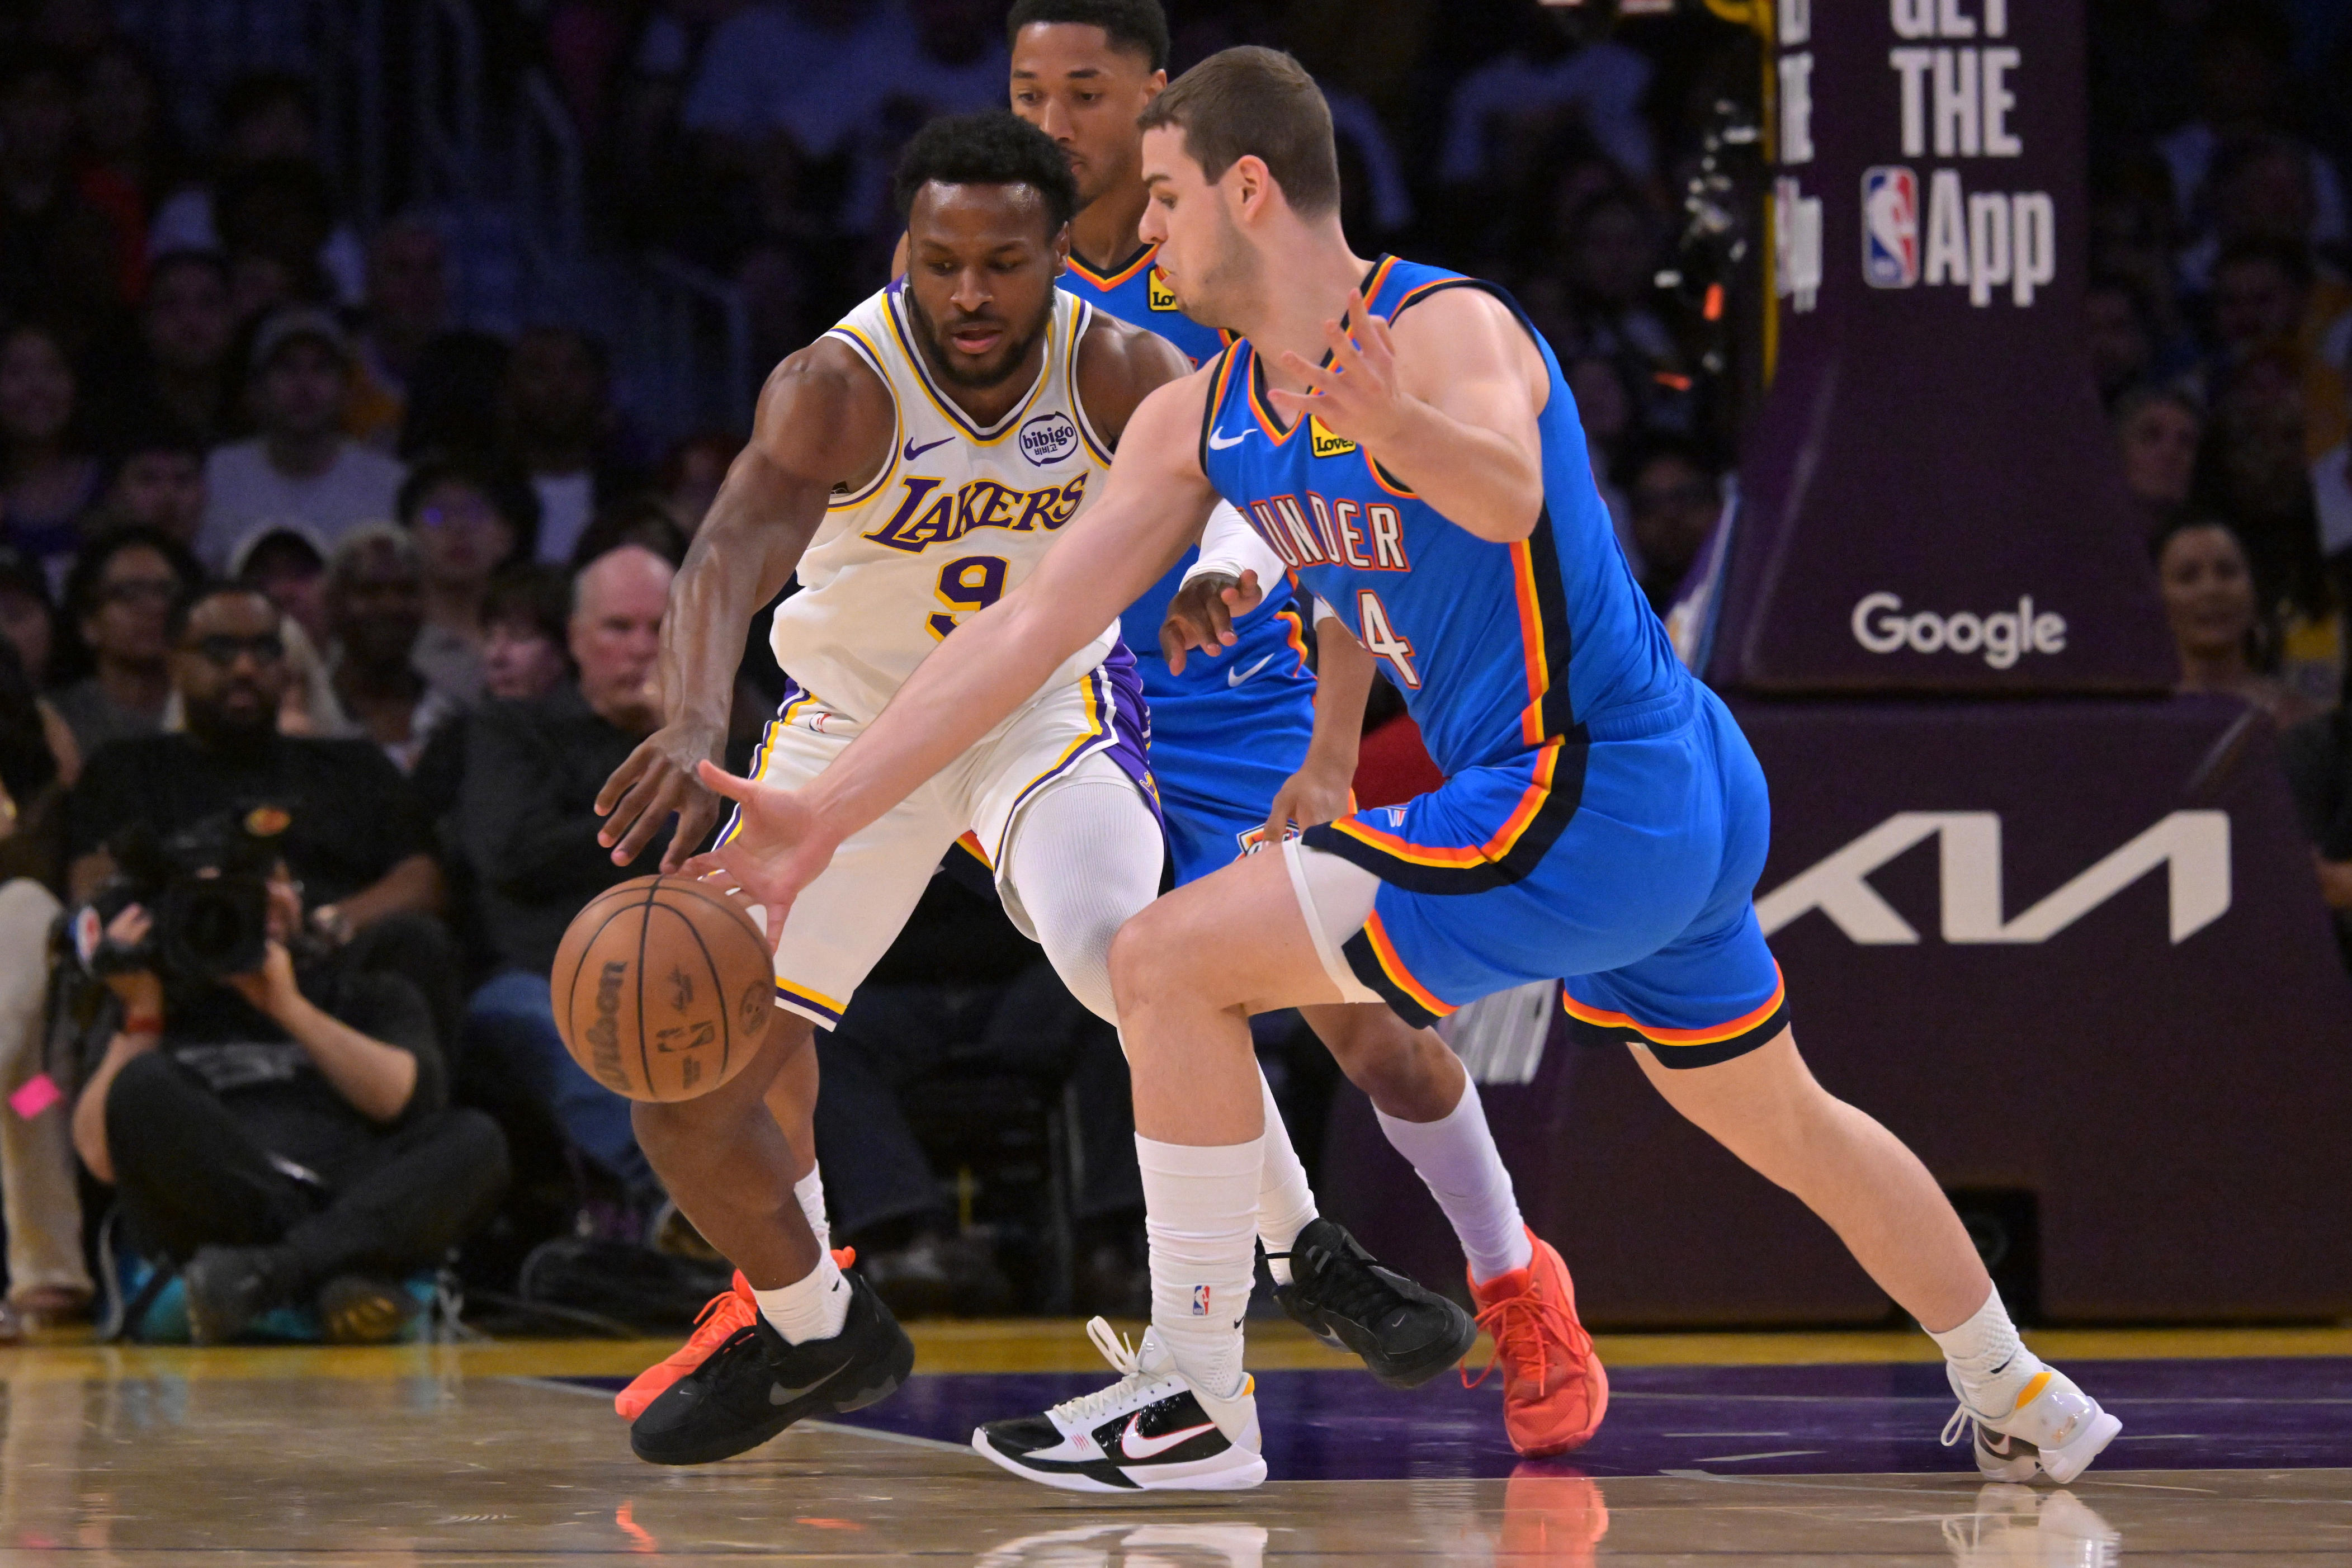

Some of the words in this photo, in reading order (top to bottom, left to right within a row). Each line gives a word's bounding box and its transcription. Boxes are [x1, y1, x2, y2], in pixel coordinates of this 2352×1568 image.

[1889, 46, 2023, 158] THE
[1924, 169, 2055, 308] App
[1023, 426, 1074, 449] bibigo
[1034, 444, 1058, 456] 비비고
[859, 469, 1090, 555] LAKERS
[1236, 490, 1411, 572] UNDER
[924, 555, 1010, 643] 9
[1357, 589, 1421, 689] 4
[1852, 591, 2067, 670] Google
